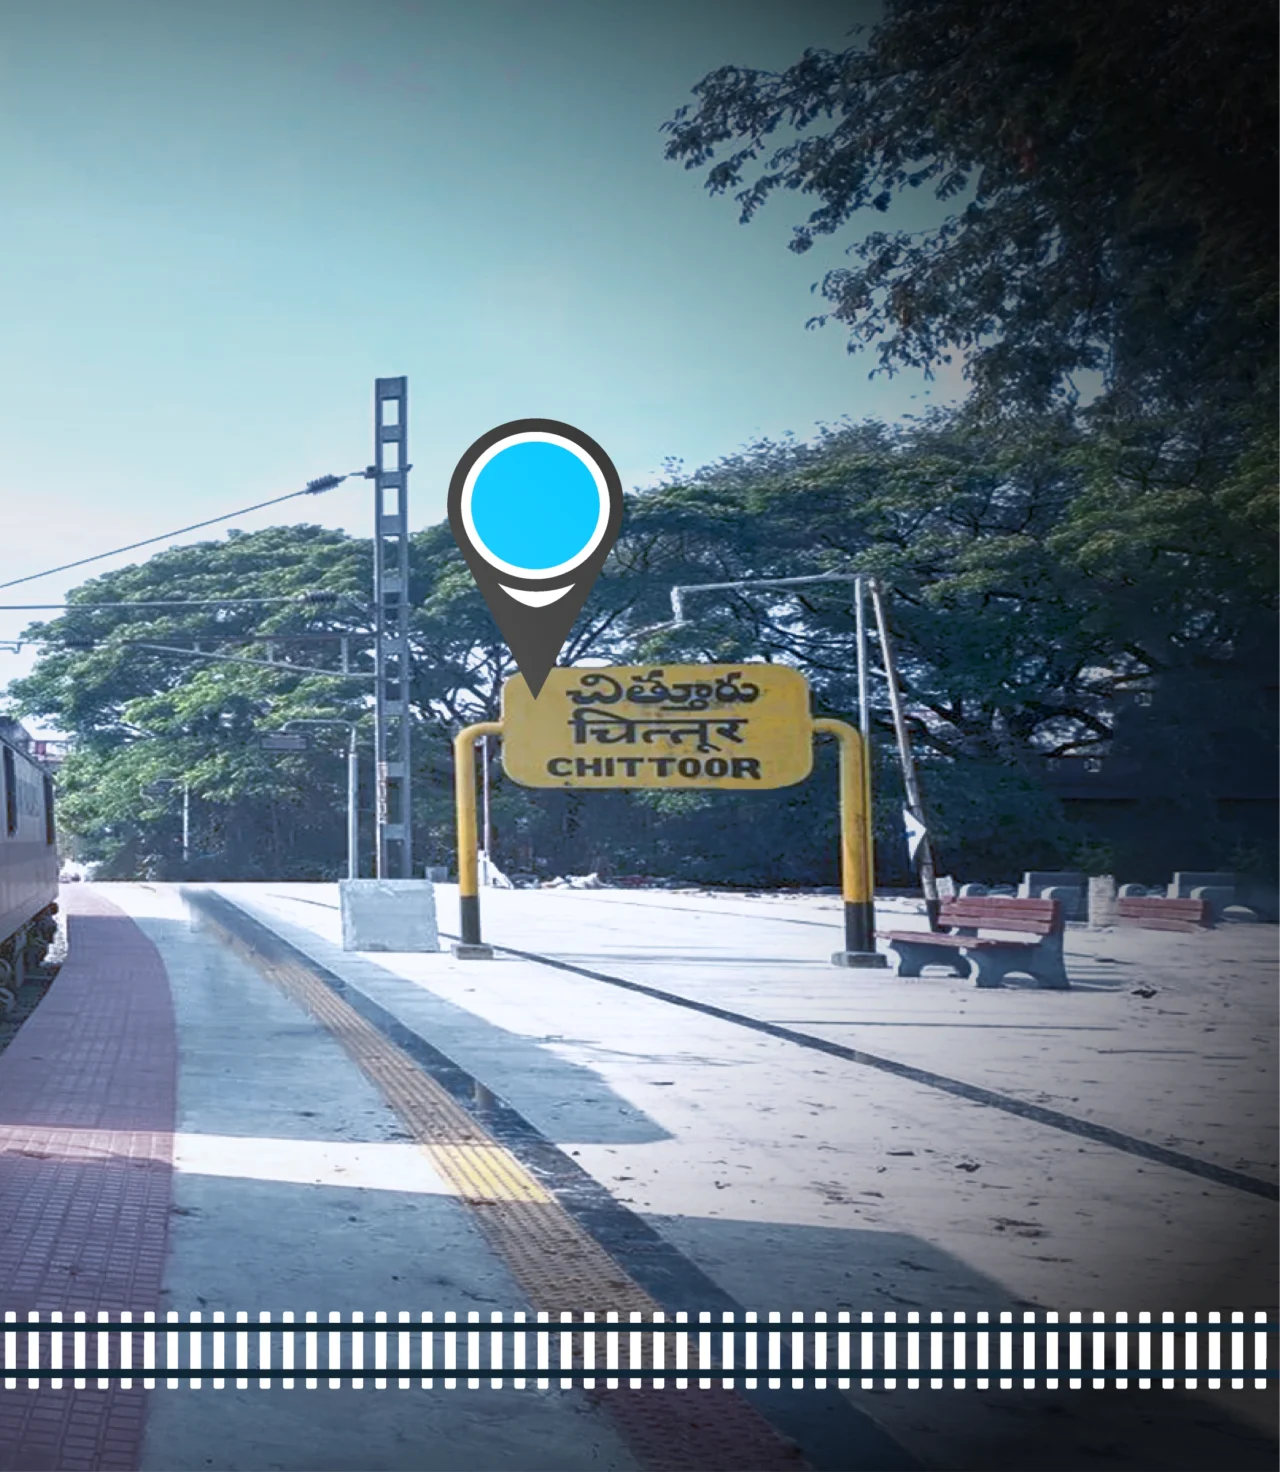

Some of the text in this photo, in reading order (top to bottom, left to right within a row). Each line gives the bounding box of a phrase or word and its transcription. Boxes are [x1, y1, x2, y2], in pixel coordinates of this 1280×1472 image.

[566, 669, 760, 711] చిత్తూరు
[568, 707, 749, 752] चित्तूर
[547, 756, 761, 780] CHITTOOR
